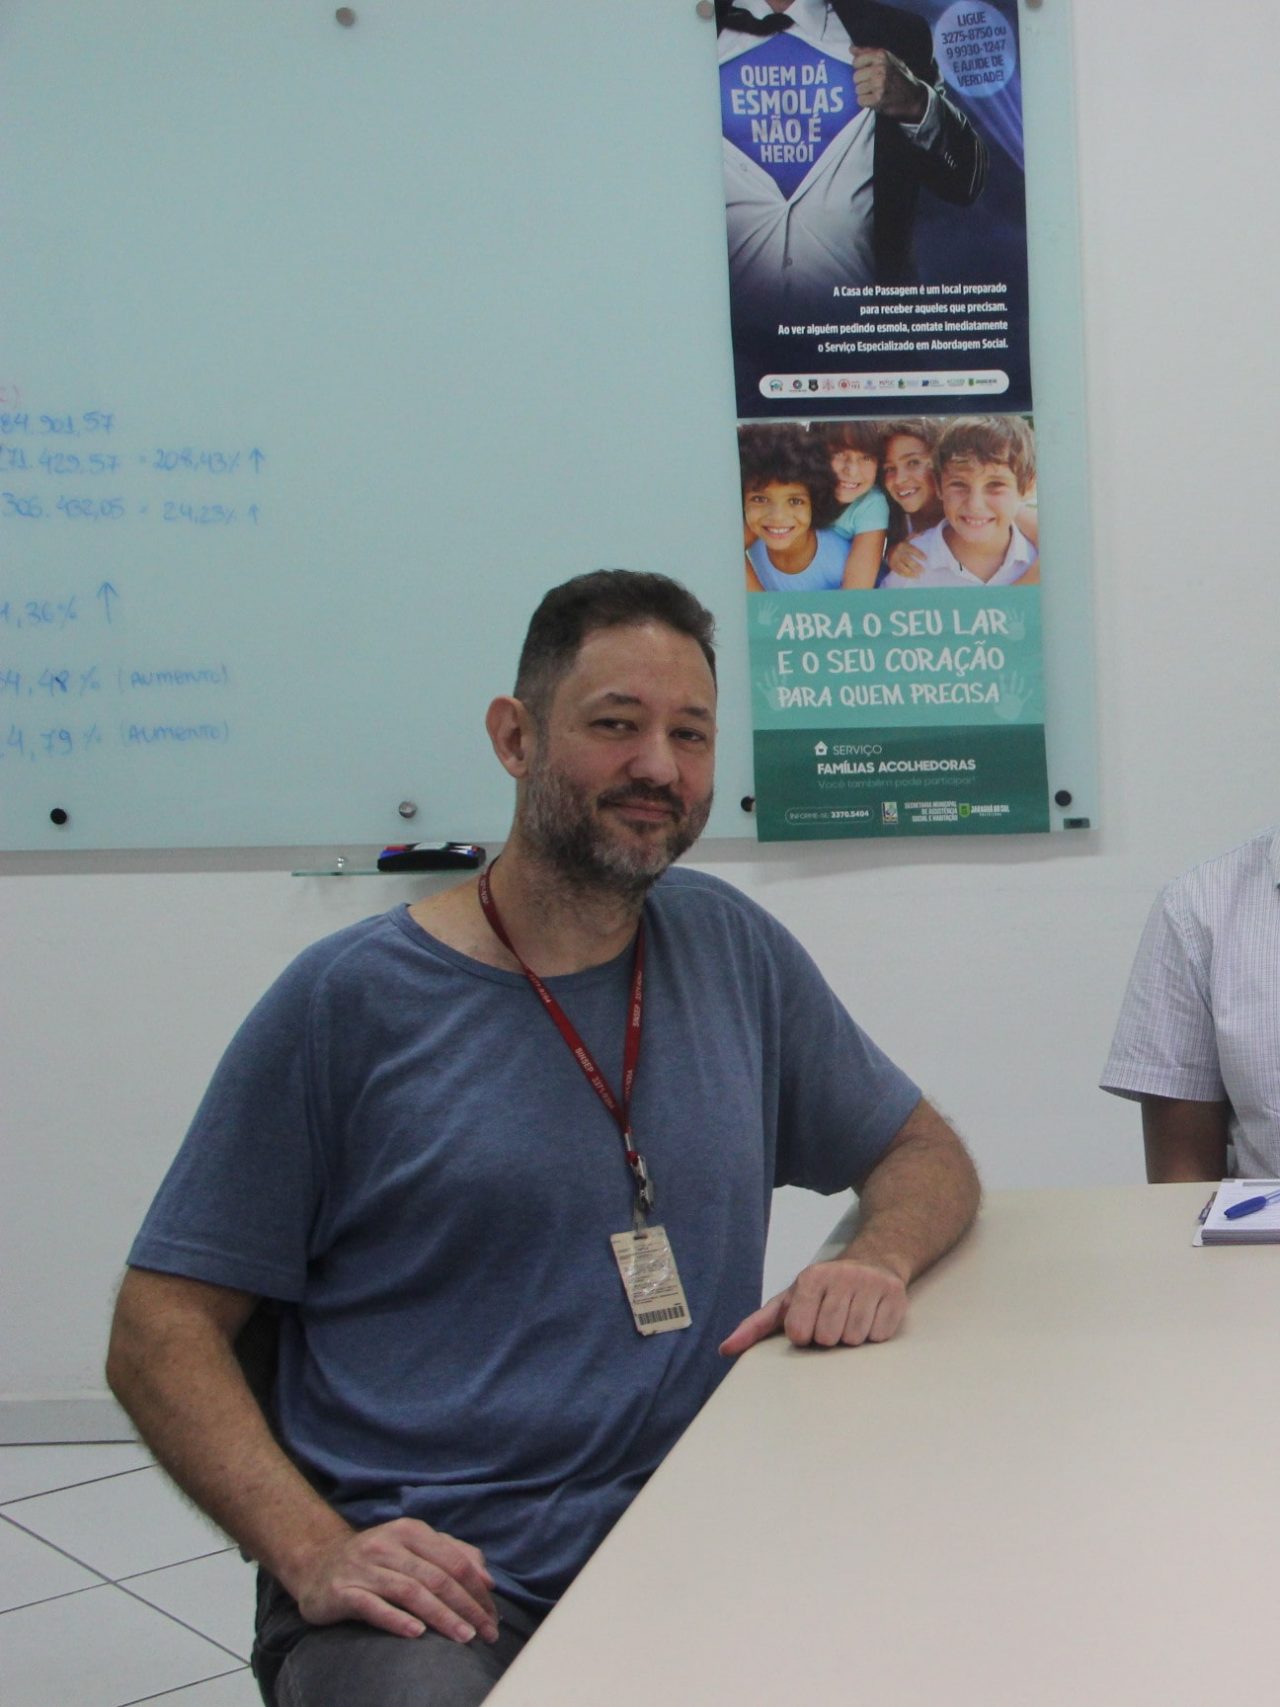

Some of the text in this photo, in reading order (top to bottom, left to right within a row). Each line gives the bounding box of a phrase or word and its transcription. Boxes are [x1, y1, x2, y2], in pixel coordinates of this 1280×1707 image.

[957, 11, 986, 26] LIGUE
[941, 26, 993, 45] 3275-8750
[946, 39, 1006, 59] 9 9930-1247
[741, 59, 828, 87] QUEM DÁ
[952, 54, 1004, 73] E AJUDE DE
[731, 86, 844, 115] ESMOLAS
[751, 113, 822, 143] NÃO É
[760, 140, 814, 163] HERÓI
[833, 282, 1007, 297] A Casa de Passagem é um local preparado
[860, 301, 1008, 316] para receber aqueles que precisam.
[778, 320, 1008, 336] Ao ver alguém pedindo esmola, contate imediatamente
[818, 338, 1008, 354] o Serviço Especializado em Abordagem Social.
[776, 608, 1009, 641] ABRA O SEU LAR
[777, 640, 1005, 677] E O SEU CORAÇÃO
[777, 682, 1000, 709] PARA QUEM PRECISA
[833, 744, 883, 757] SERVIÇO
[817, 759, 976, 775] FAMÍLIAS ACOLHEDORAS
[818, 779, 846, 789] Você
[895, 776, 922, 788] pode
